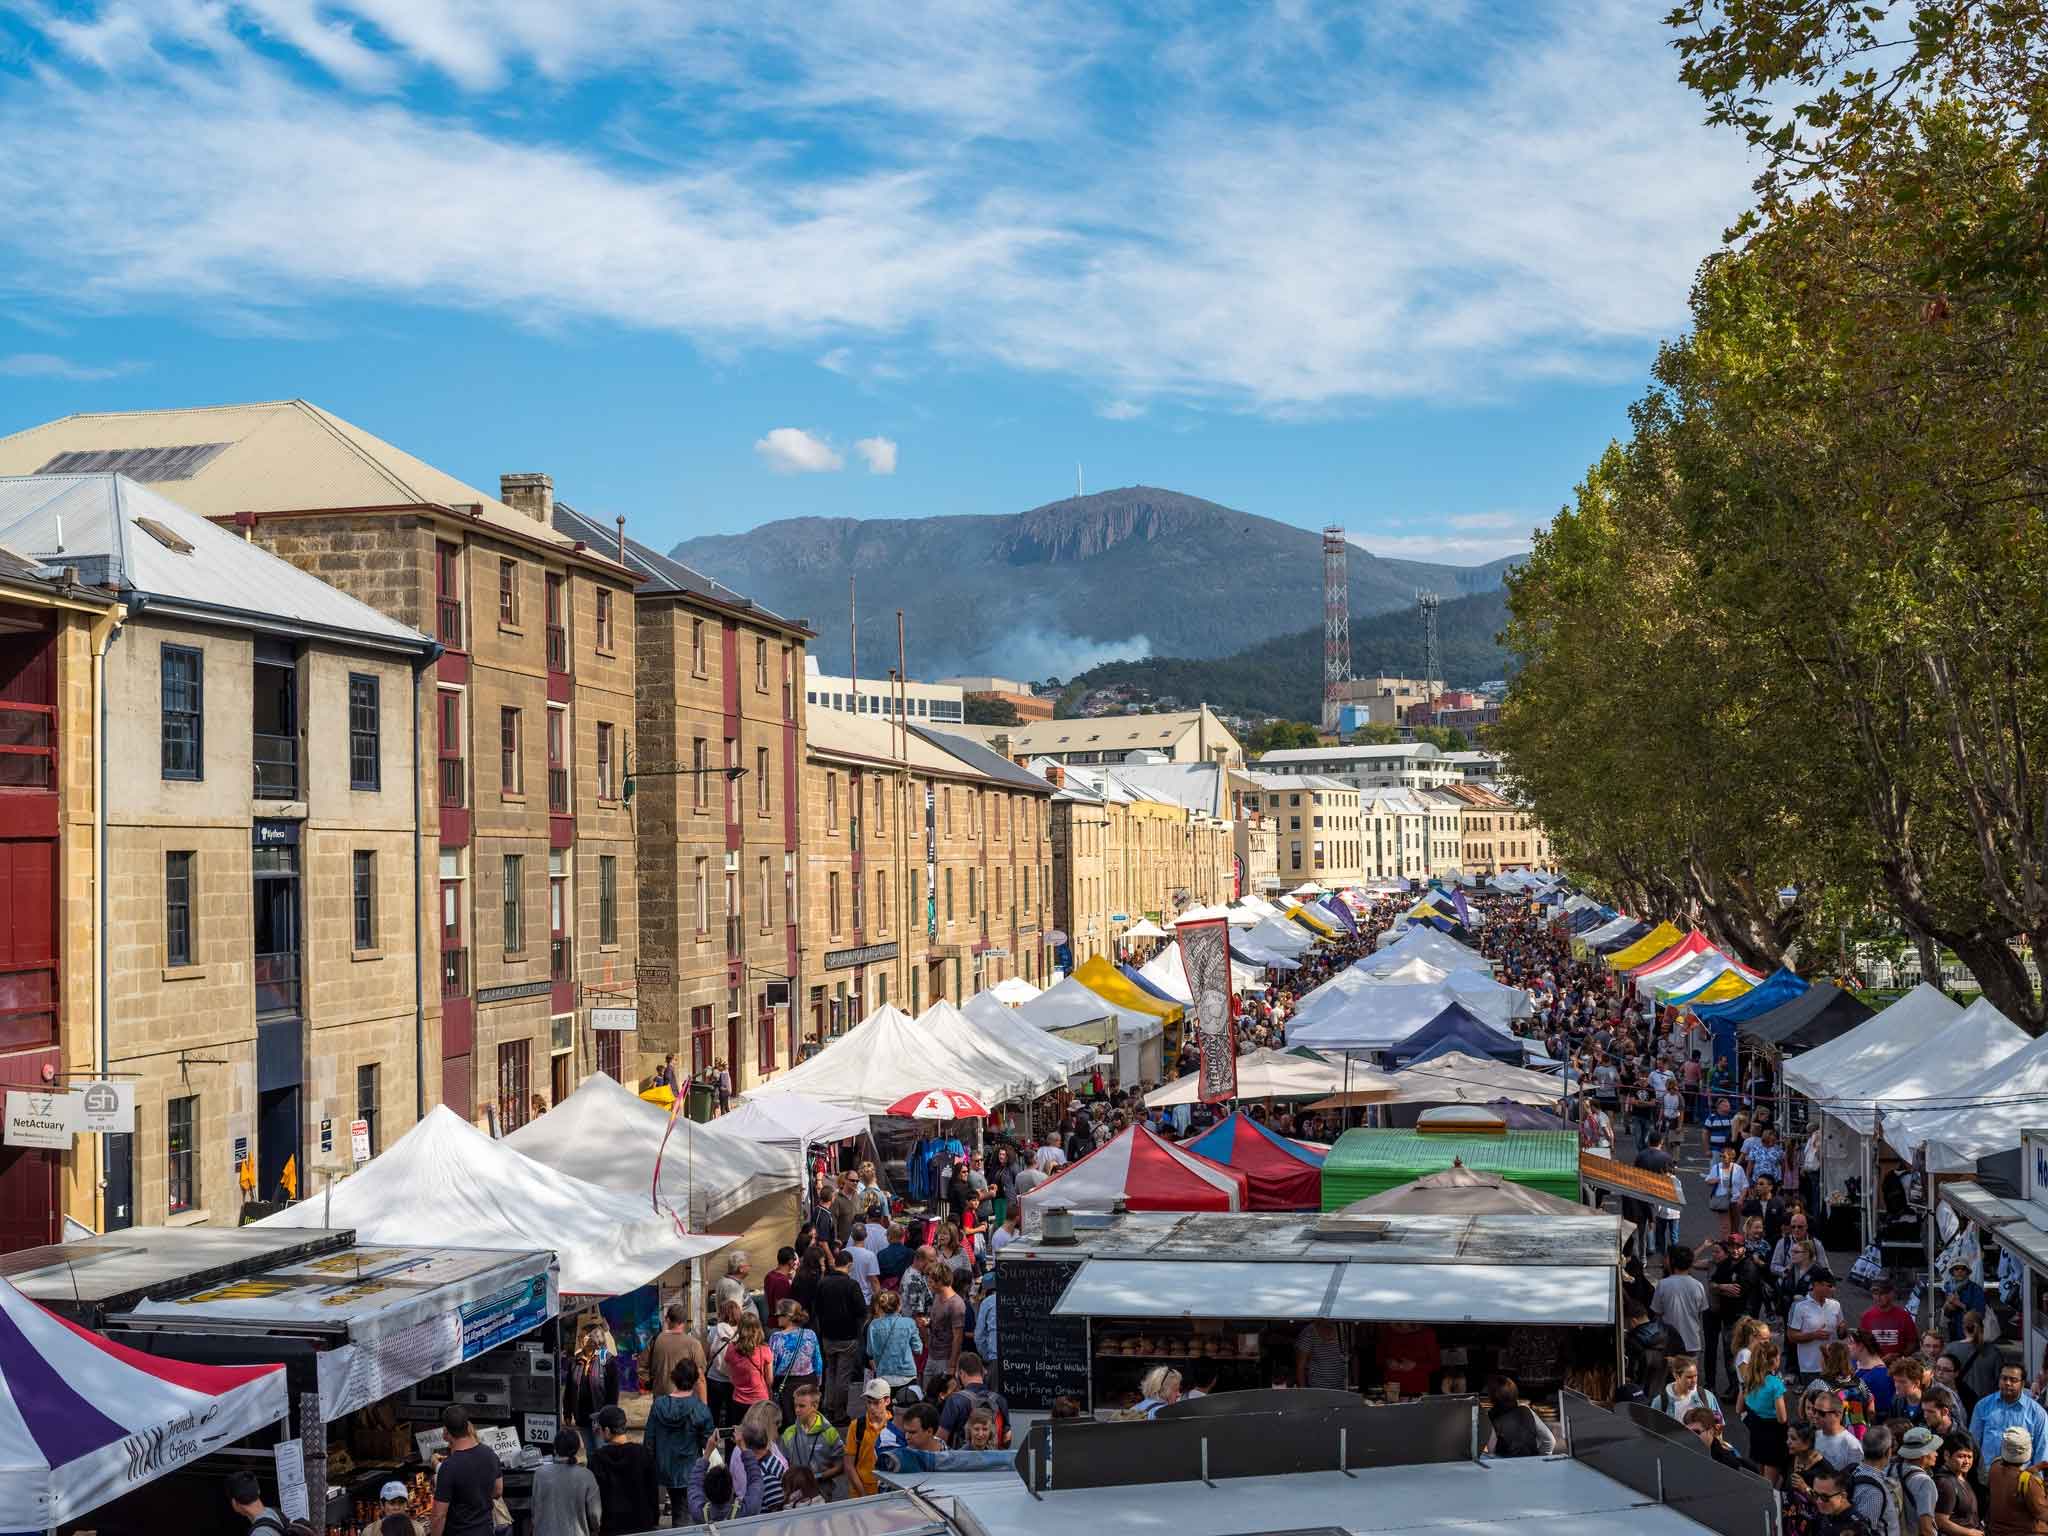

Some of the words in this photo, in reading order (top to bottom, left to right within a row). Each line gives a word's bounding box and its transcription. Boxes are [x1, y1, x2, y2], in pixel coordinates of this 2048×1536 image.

[592, 1013, 635, 1024] ASPECT
[13, 1117, 65, 1132] NetActuary
[1025, 1280, 1066, 1296] Kitche
[1003, 1360, 1031, 1375] Bruny
[1035, 1361, 1061, 1371] Island
[168, 1410, 195, 1438] French
[530, 1429, 549, 1441] $20
[169, 1440, 198, 1463] Crêpes
